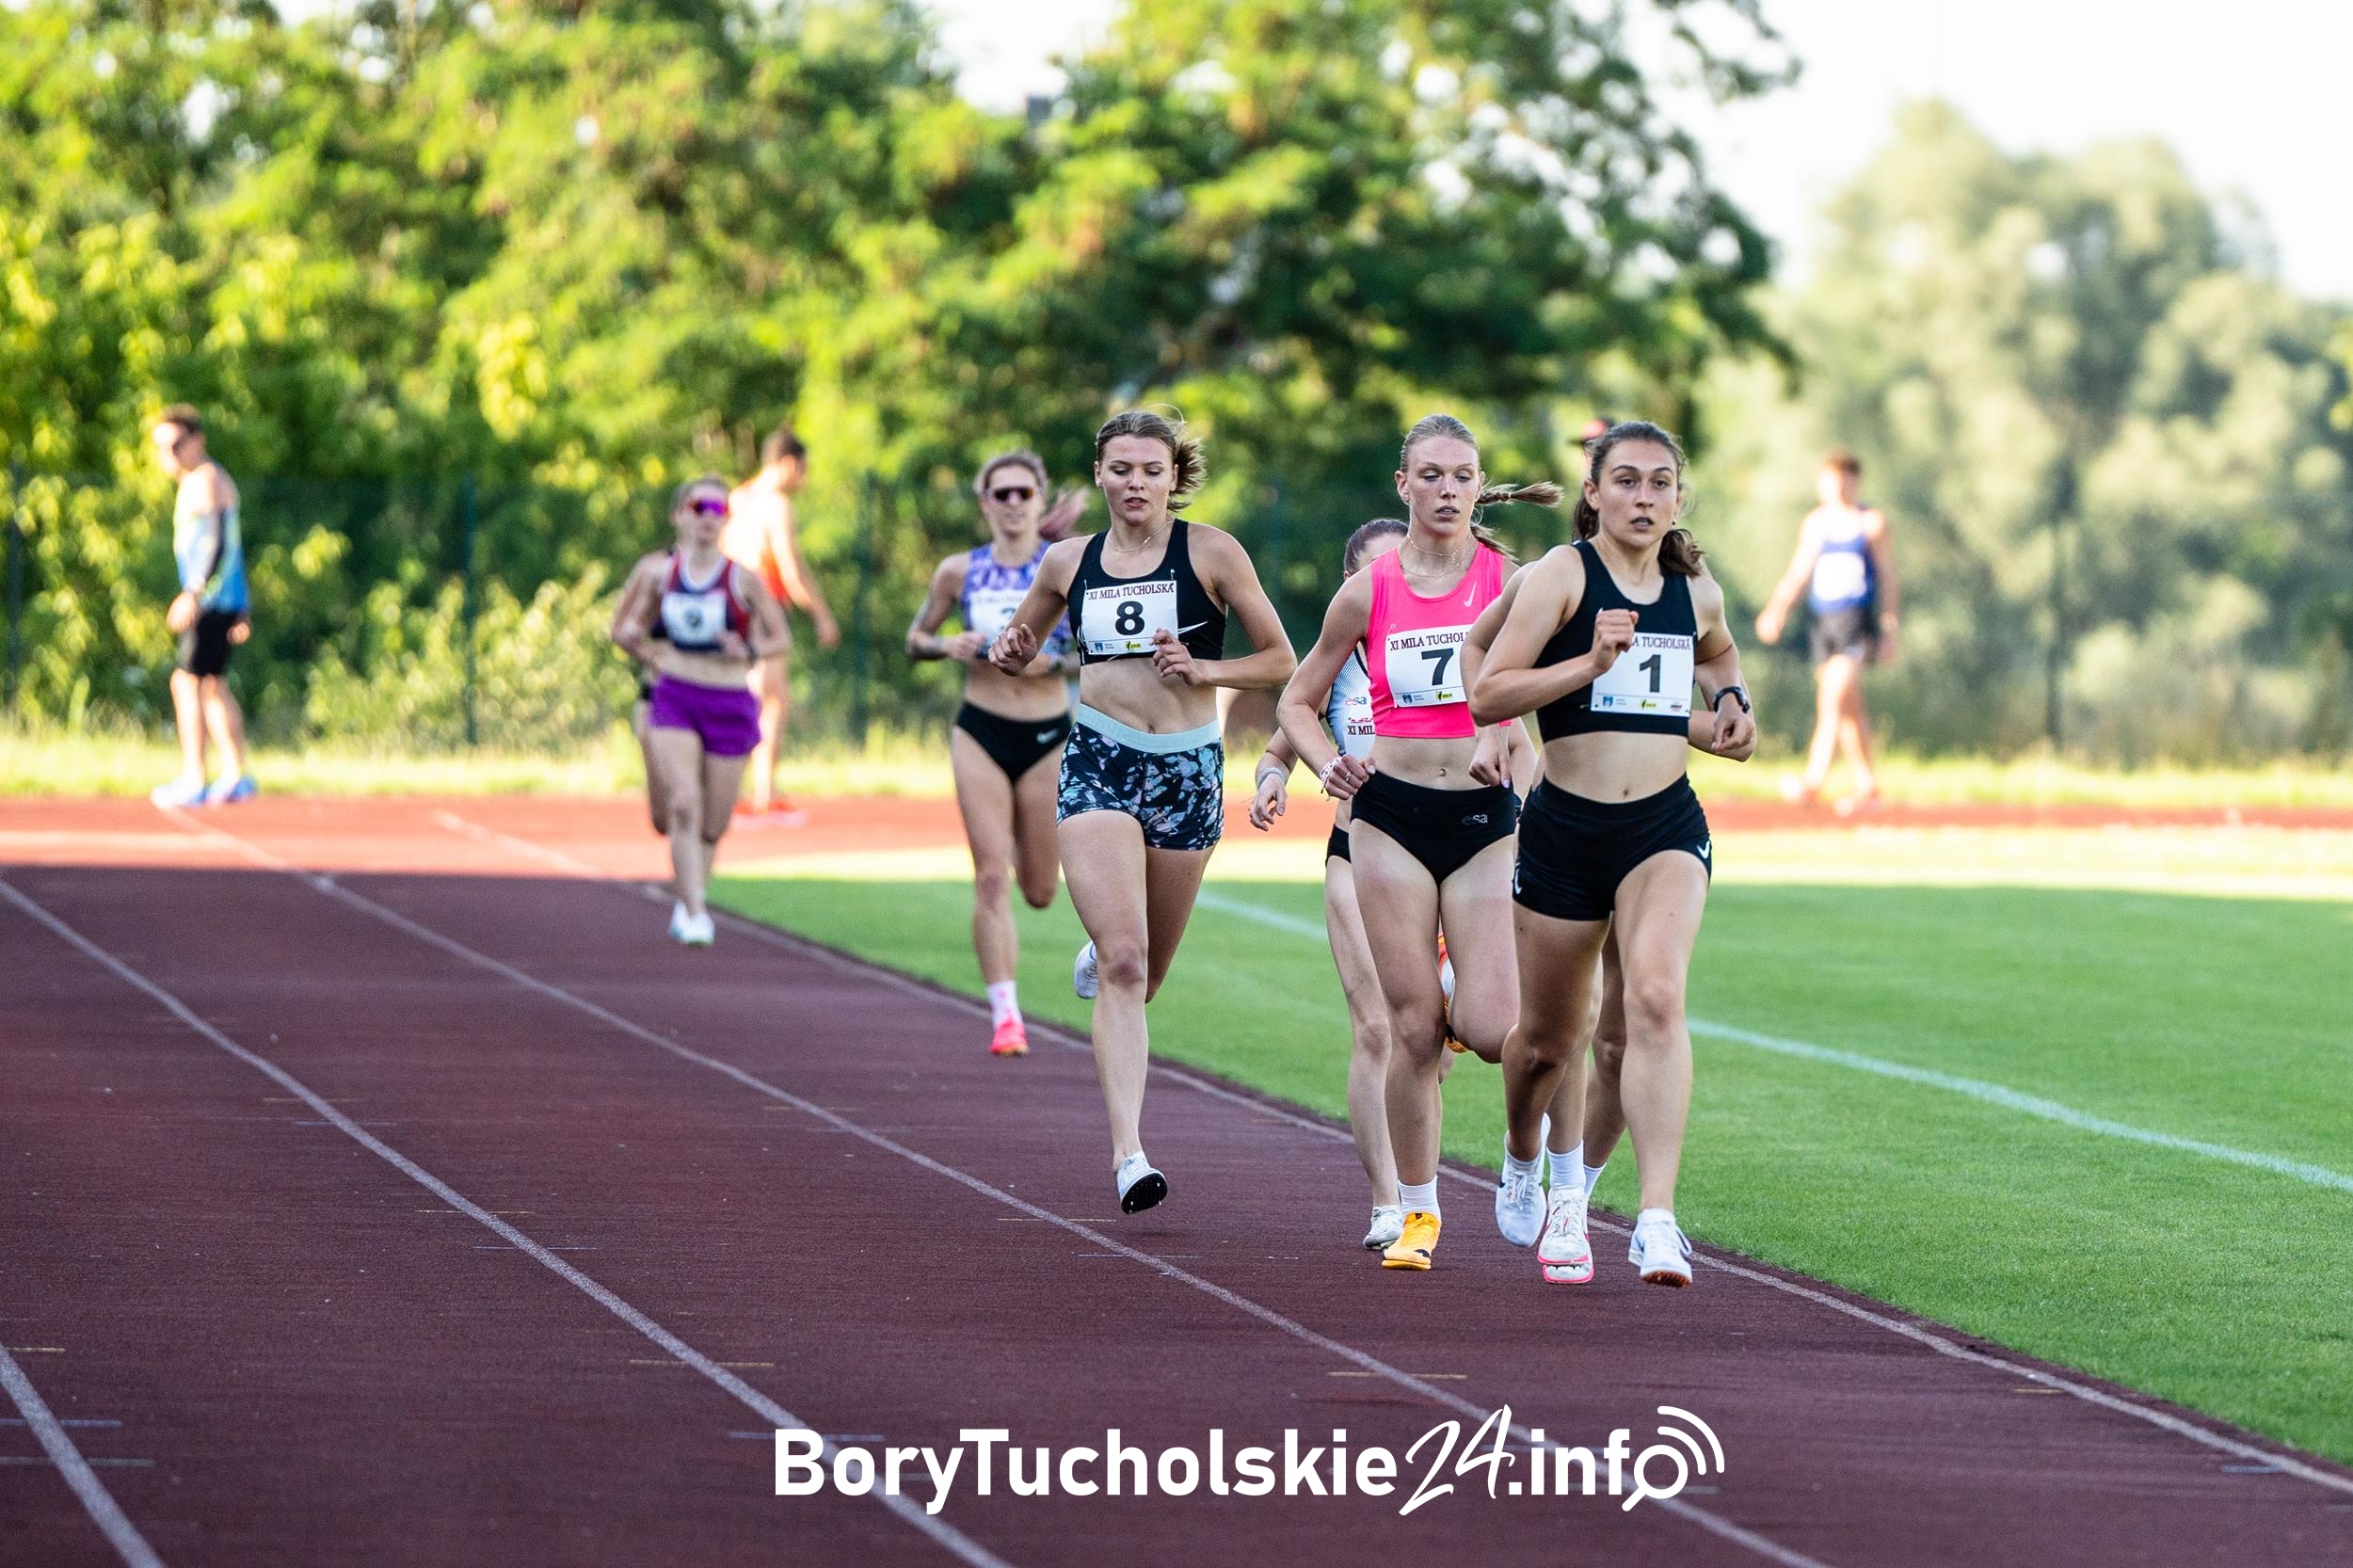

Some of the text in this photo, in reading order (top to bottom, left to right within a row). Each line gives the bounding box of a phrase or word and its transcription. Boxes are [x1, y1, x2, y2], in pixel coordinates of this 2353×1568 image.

[1099, 588, 1121, 600] MILA
[1123, 584, 1174, 596] TUCHOLSKA
[1115, 600, 1144, 635] 8
[1390, 640, 1400, 651] XI
[1401, 635, 1425, 649] MILA
[1642, 636, 1690, 649] TUCHOLSKA
[1420, 648, 1454, 687] 7
[1639, 653, 1661, 694] 1
[1348, 726, 1355, 735] XI
